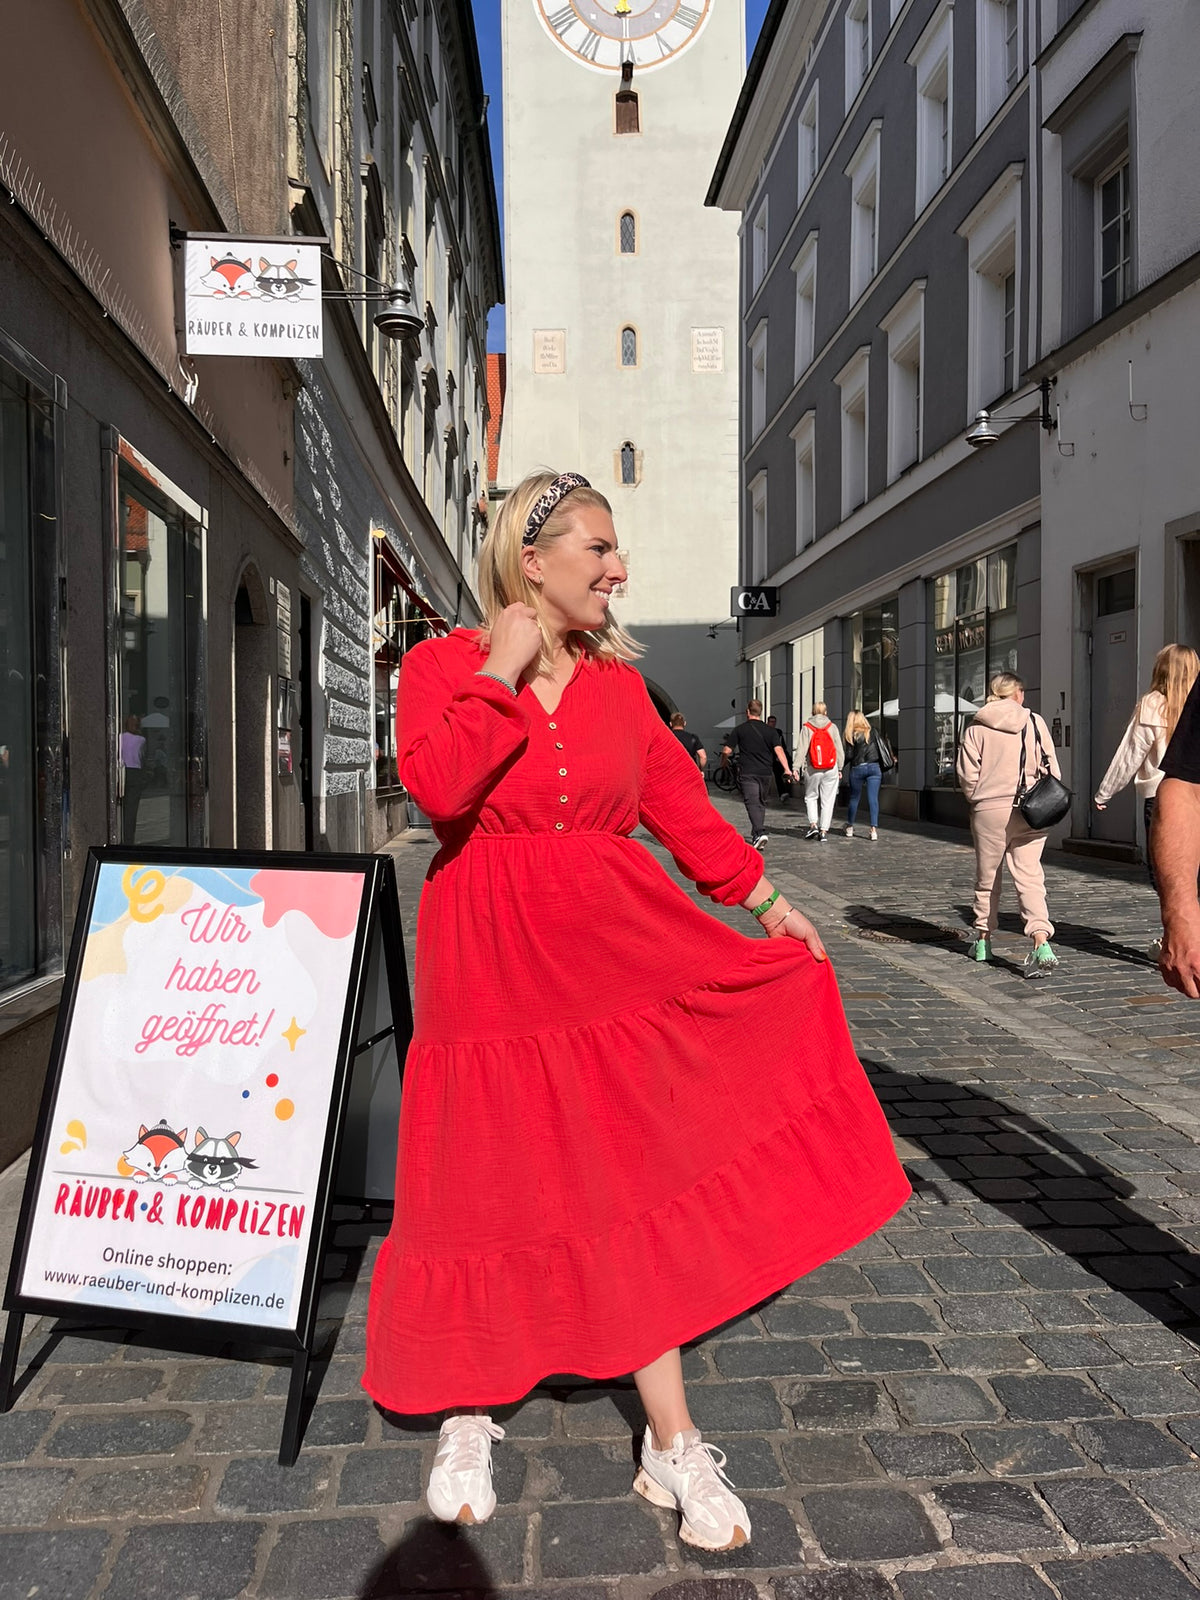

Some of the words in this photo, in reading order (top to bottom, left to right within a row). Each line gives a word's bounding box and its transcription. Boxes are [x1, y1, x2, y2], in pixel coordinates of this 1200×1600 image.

[188, 318, 232, 336] RÄUBER
[239, 323, 248, 337] &
[738, 592, 771, 610] C&A
[181, 903, 251, 944] Wir
[164, 958, 261, 995] haben
[135, 1002, 275, 1057] geöffnet!
[54, 1180, 137, 1220] RÄUBER
[147, 1191, 164, 1224] &
[102, 1247, 154, 1268] Online
[158, 1255, 233, 1276] shoppen:
[44, 1270, 285, 1310] www.raeuber-und-komplizen.de
